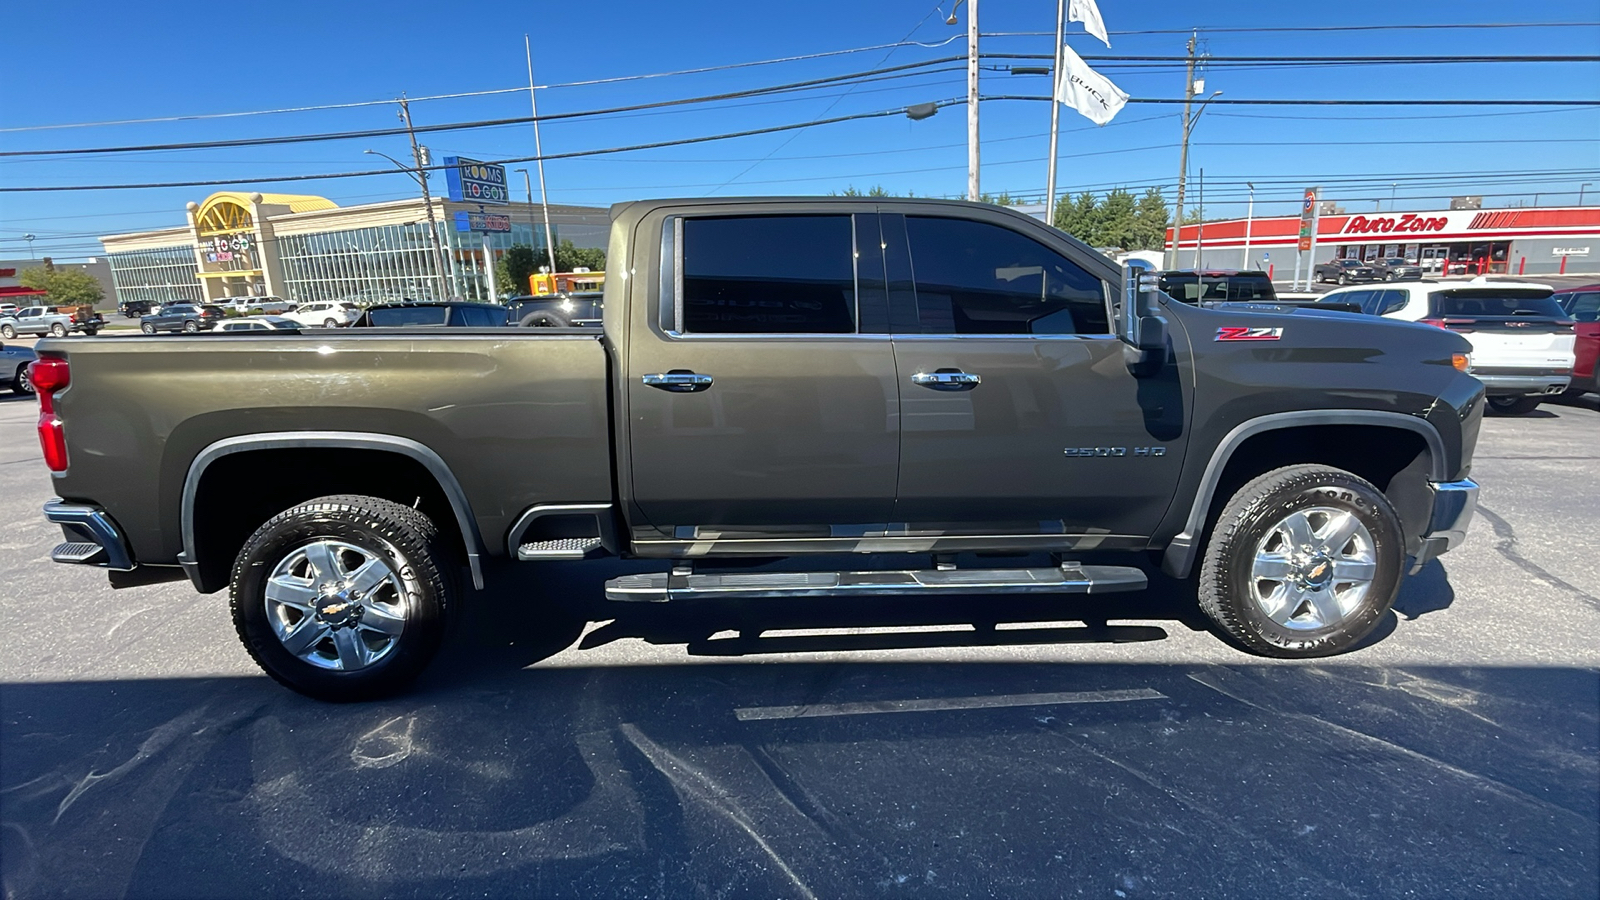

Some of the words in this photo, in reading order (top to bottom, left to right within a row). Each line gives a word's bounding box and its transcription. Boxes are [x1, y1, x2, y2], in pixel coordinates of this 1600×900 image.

[1070, 74, 1110, 111] BUICK
[464, 165, 502, 183] ROOMS
[466, 182, 480, 197] TO
[483, 185, 499, 199] GO
[485, 215, 510, 231] KIDS
[1213, 326, 1284, 341] Z71
[1063, 446, 1127, 458] 2500
[1134, 446, 1166, 457] HD
